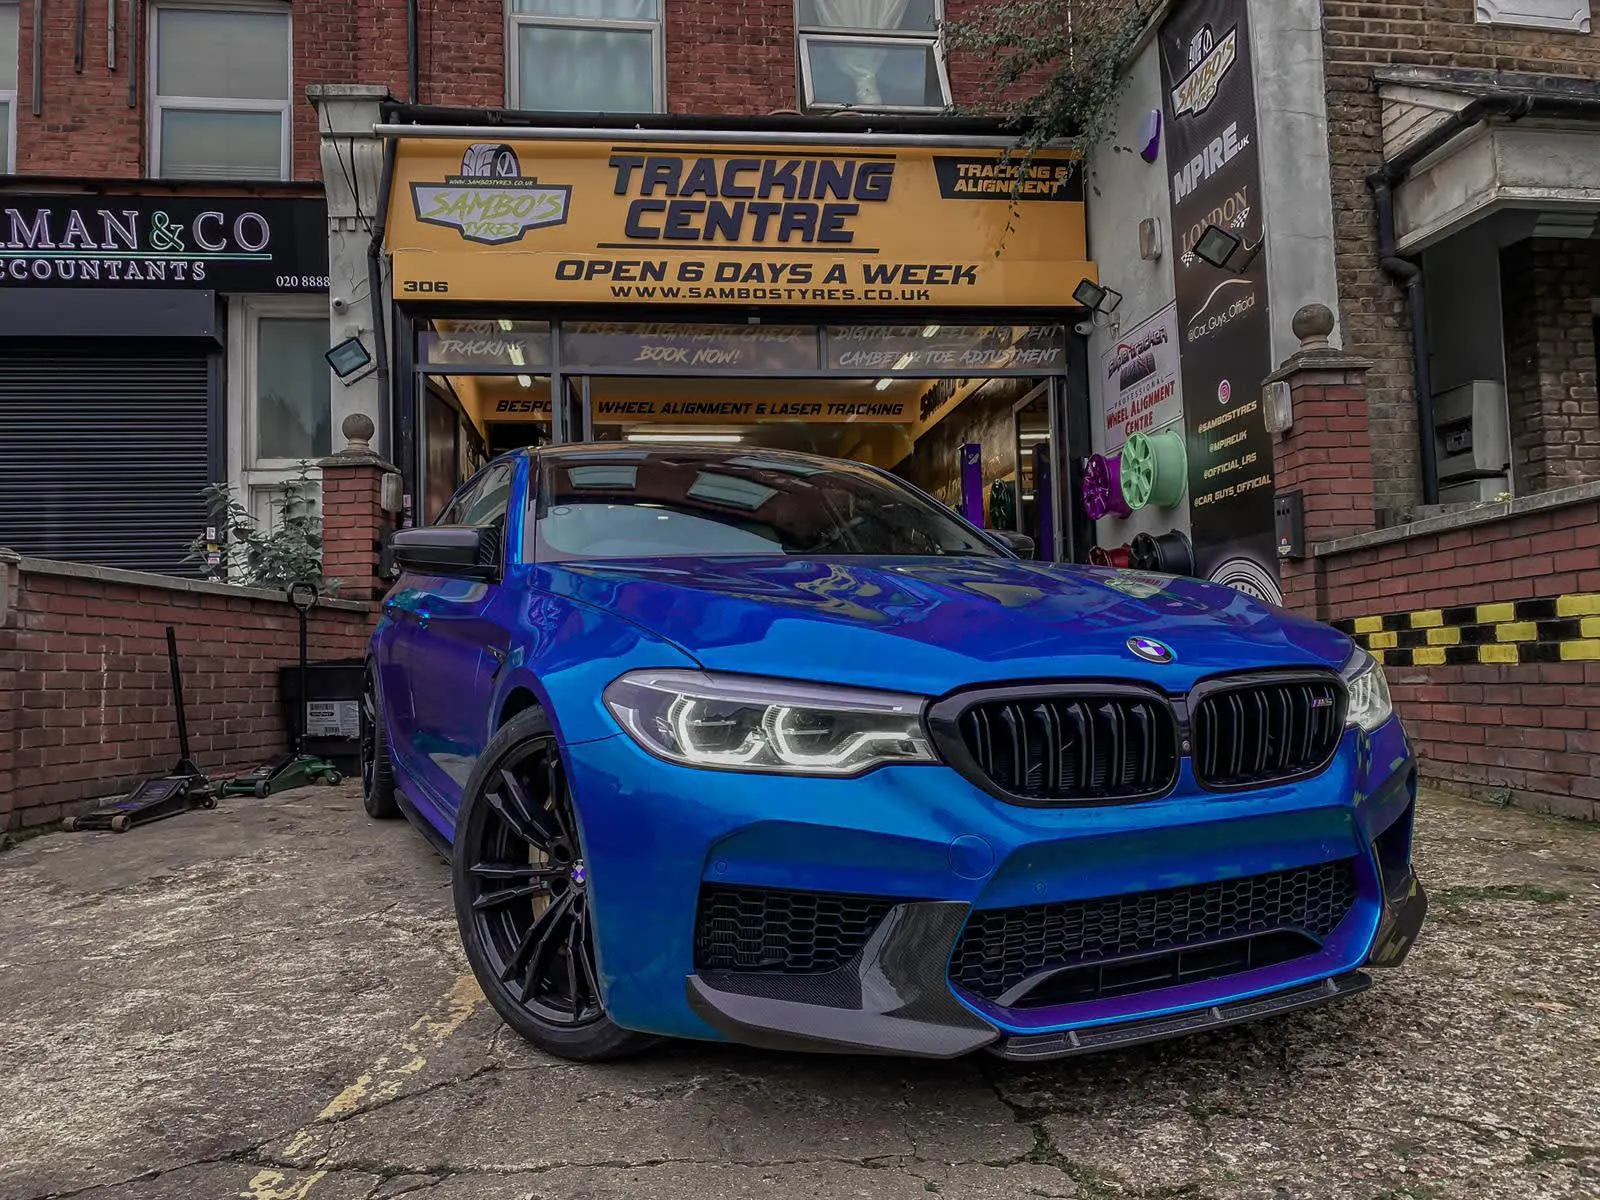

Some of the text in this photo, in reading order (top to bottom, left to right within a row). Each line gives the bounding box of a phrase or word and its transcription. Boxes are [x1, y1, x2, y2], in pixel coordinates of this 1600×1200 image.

[957, 163, 1051, 179] TRACKNG
[1174, 121, 1250, 205] MPIRE UK
[609, 156, 896, 201] TRACKING
[422, 189, 563, 222] SAMBO'S
[463, 221, 520, 236] TYRES
[624, 199, 860, 243] CENTRE
[0, 259, 206, 281] COUNTANTS
[275, 275, 330, 286] 020 8888
[554, 259, 979, 286] OPEN 6 DAYS A WEEK
[403, 280, 449, 293] 306
[610, 286, 930, 301] WWW.SAMBOSTYRES.CO.UK
[441, 339, 526, 357] TRACKI
[634, 345, 741, 366] BOOK NOW!
[839, 350, 905, 366] CAMBE
[926, 350, 956, 365] TOE
[598, 401, 656, 414] WHEEL
[660, 402, 751, 415] ALIGNMENT
[755, 403, 765, 415] &
[769, 402, 826, 416] LASER
[827, 403, 904, 416] TRACKING
[1107, 407, 1129, 430] WHEEL
[1130, 380, 1176, 417] ALIGNMENT
[1125, 411, 1153, 436] CENTRE
[1198, 400, 1257, 434] @SAMBOSTYRES
